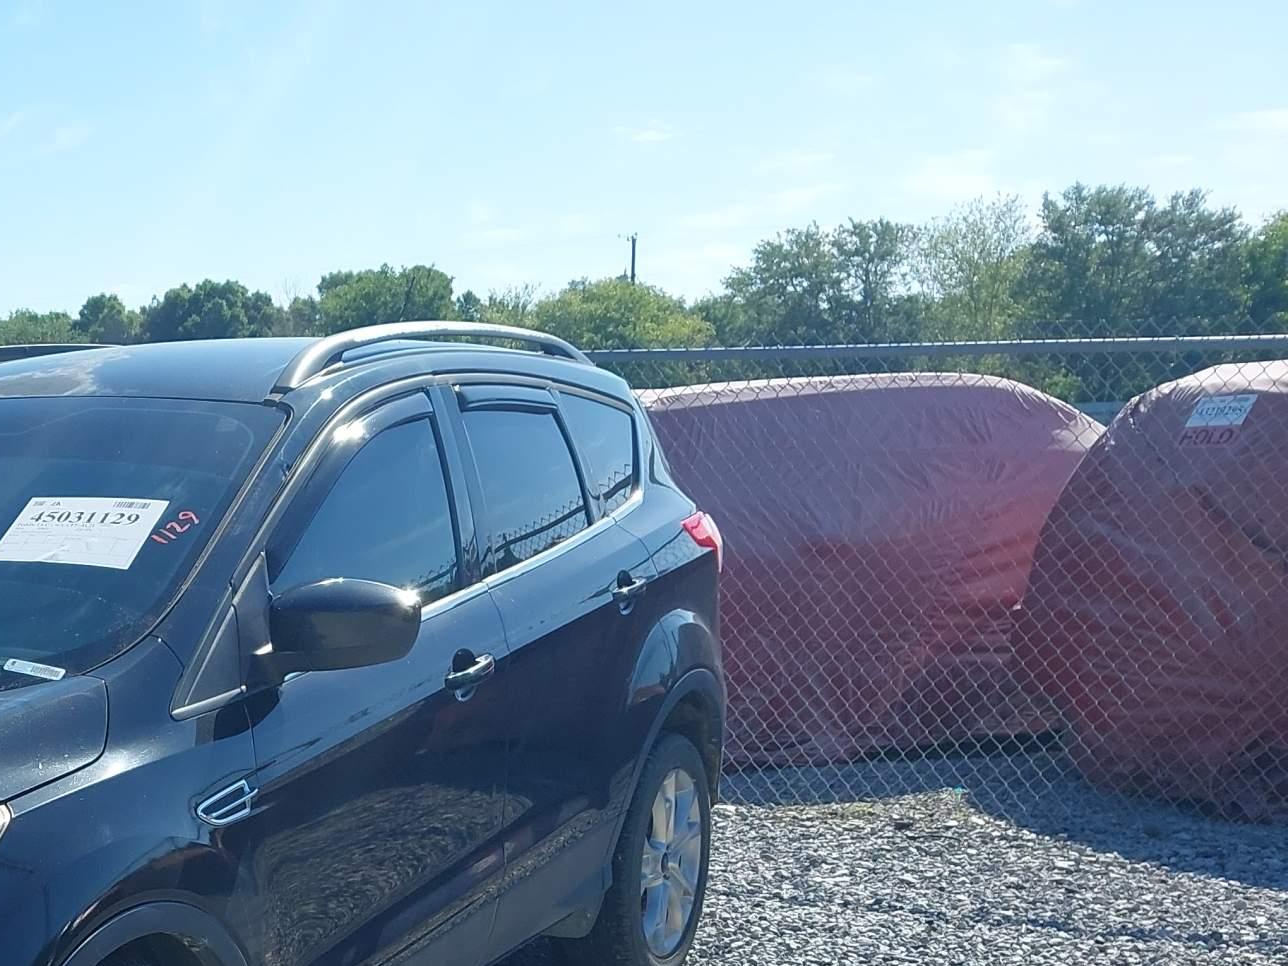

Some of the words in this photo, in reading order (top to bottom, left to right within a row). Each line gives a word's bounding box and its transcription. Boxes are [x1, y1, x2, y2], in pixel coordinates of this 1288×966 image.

[1178, 428, 1235, 446] HOLD
[30, 511, 141, 526] 45031129
[151, 511, 199, 544] 1129
